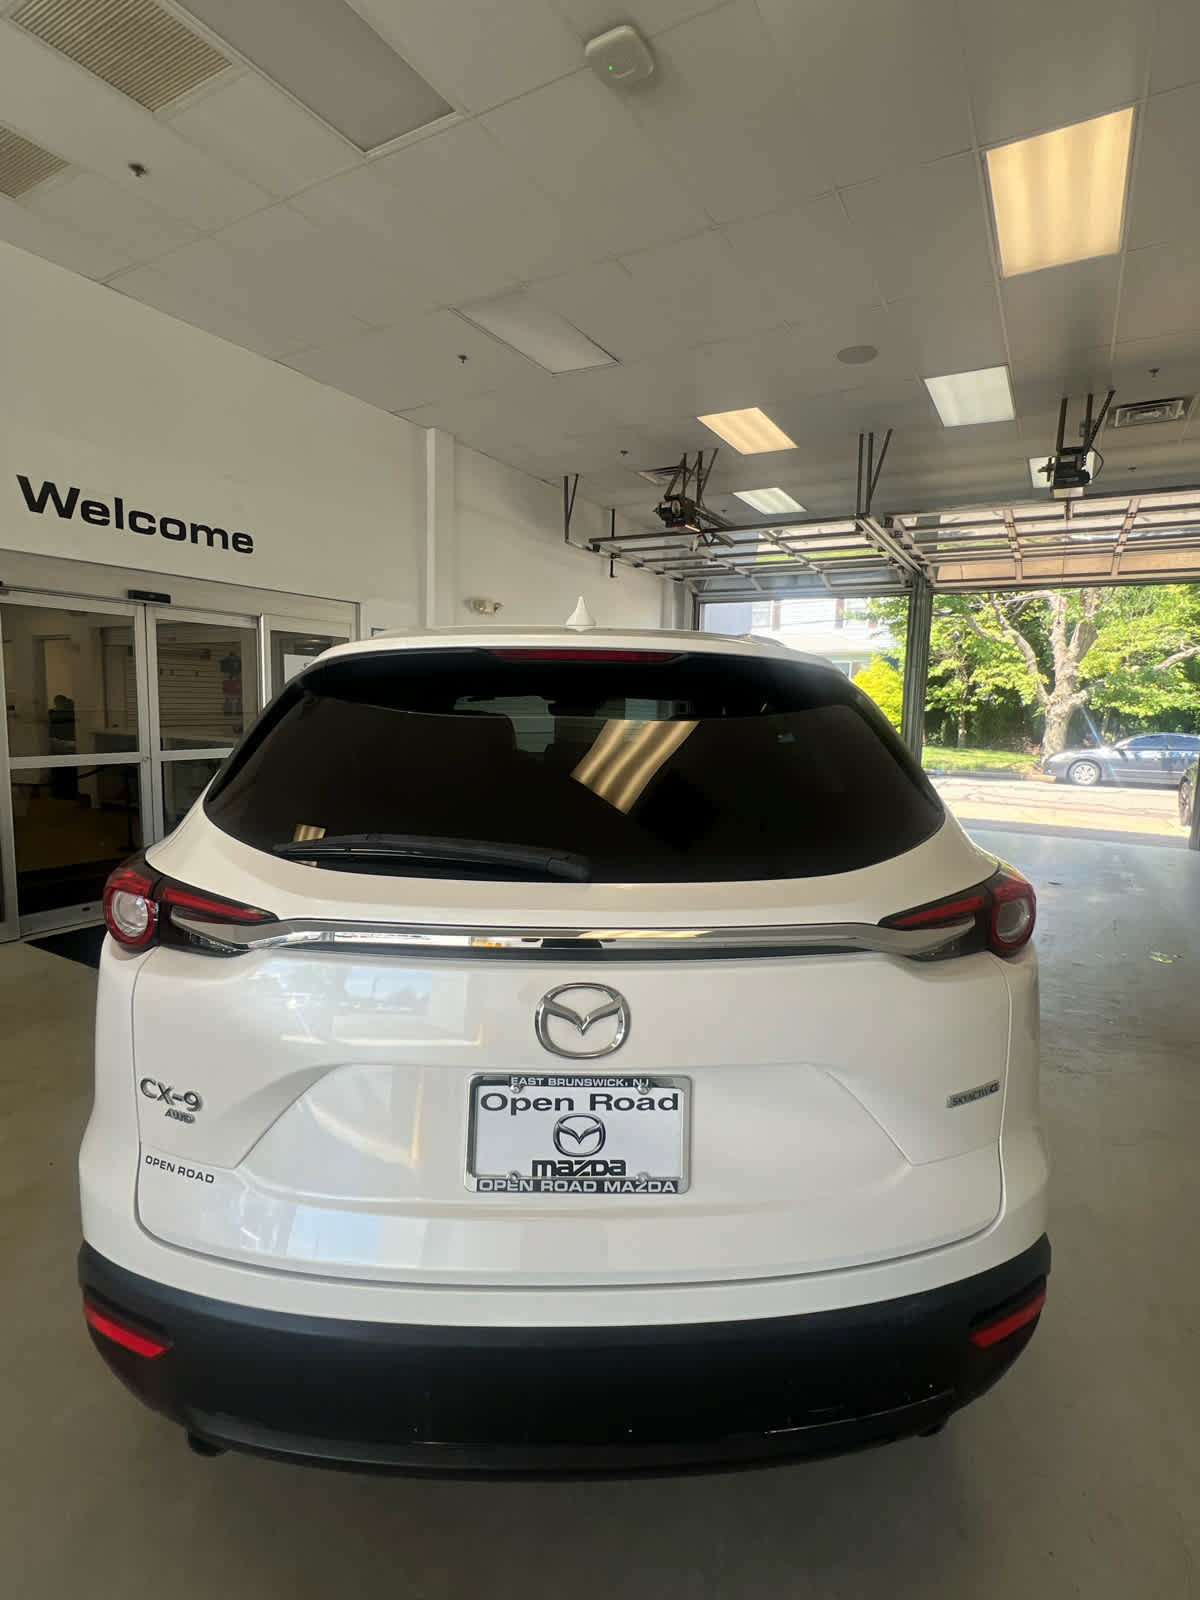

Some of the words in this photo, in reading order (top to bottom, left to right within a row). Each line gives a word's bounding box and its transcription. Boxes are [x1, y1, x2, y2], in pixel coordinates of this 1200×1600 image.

[16, 474, 254, 554] Welcome
[511, 1077, 544, 1086] EAST
[140, 1078, 203, 1112] CX-9
[480, 1093, 575, 1116] Open
[589, 1093, 678, 1111] Road
[145, 1155, 175, 1173] OPEN
[177, 1166, 215, 1184] ROAD
[532, 1160, 626, 1177] mazda
[479, 1180, 534, 1192] OPEN
[540, 1180, 598, 1192] ROAD
[603, 1180, 676, 1193] MAZDA
